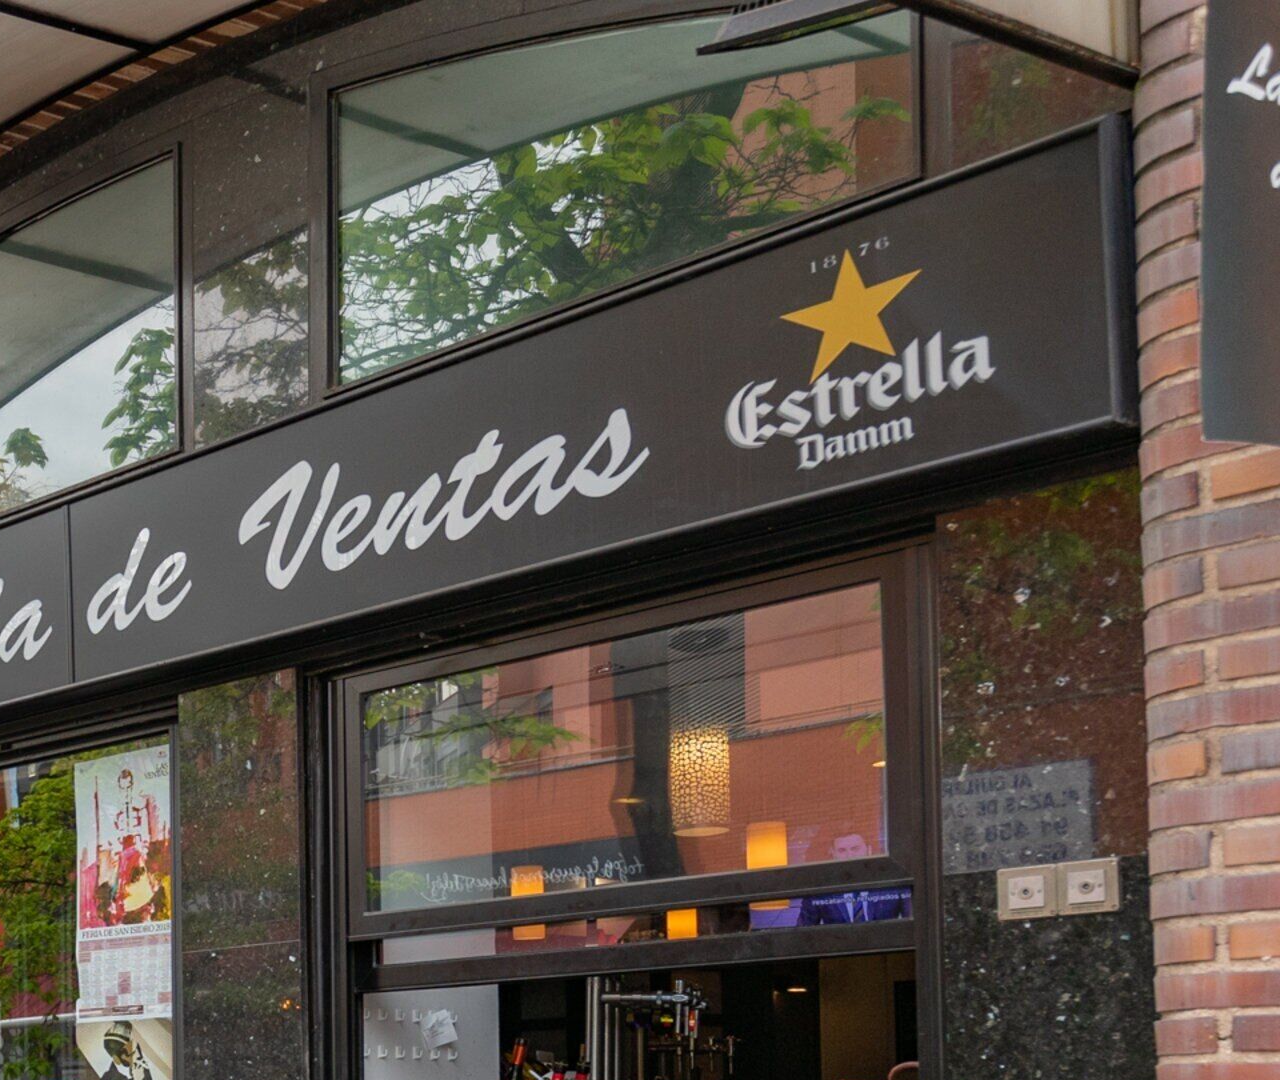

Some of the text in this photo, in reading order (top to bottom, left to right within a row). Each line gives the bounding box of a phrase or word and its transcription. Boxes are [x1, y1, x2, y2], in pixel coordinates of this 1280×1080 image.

[724, 330, 996, 448] Estrella
[794, 416, 915, 471] Damm
[86, 527, 192, 634] de
[238, 408, 651, 590] Ventas
